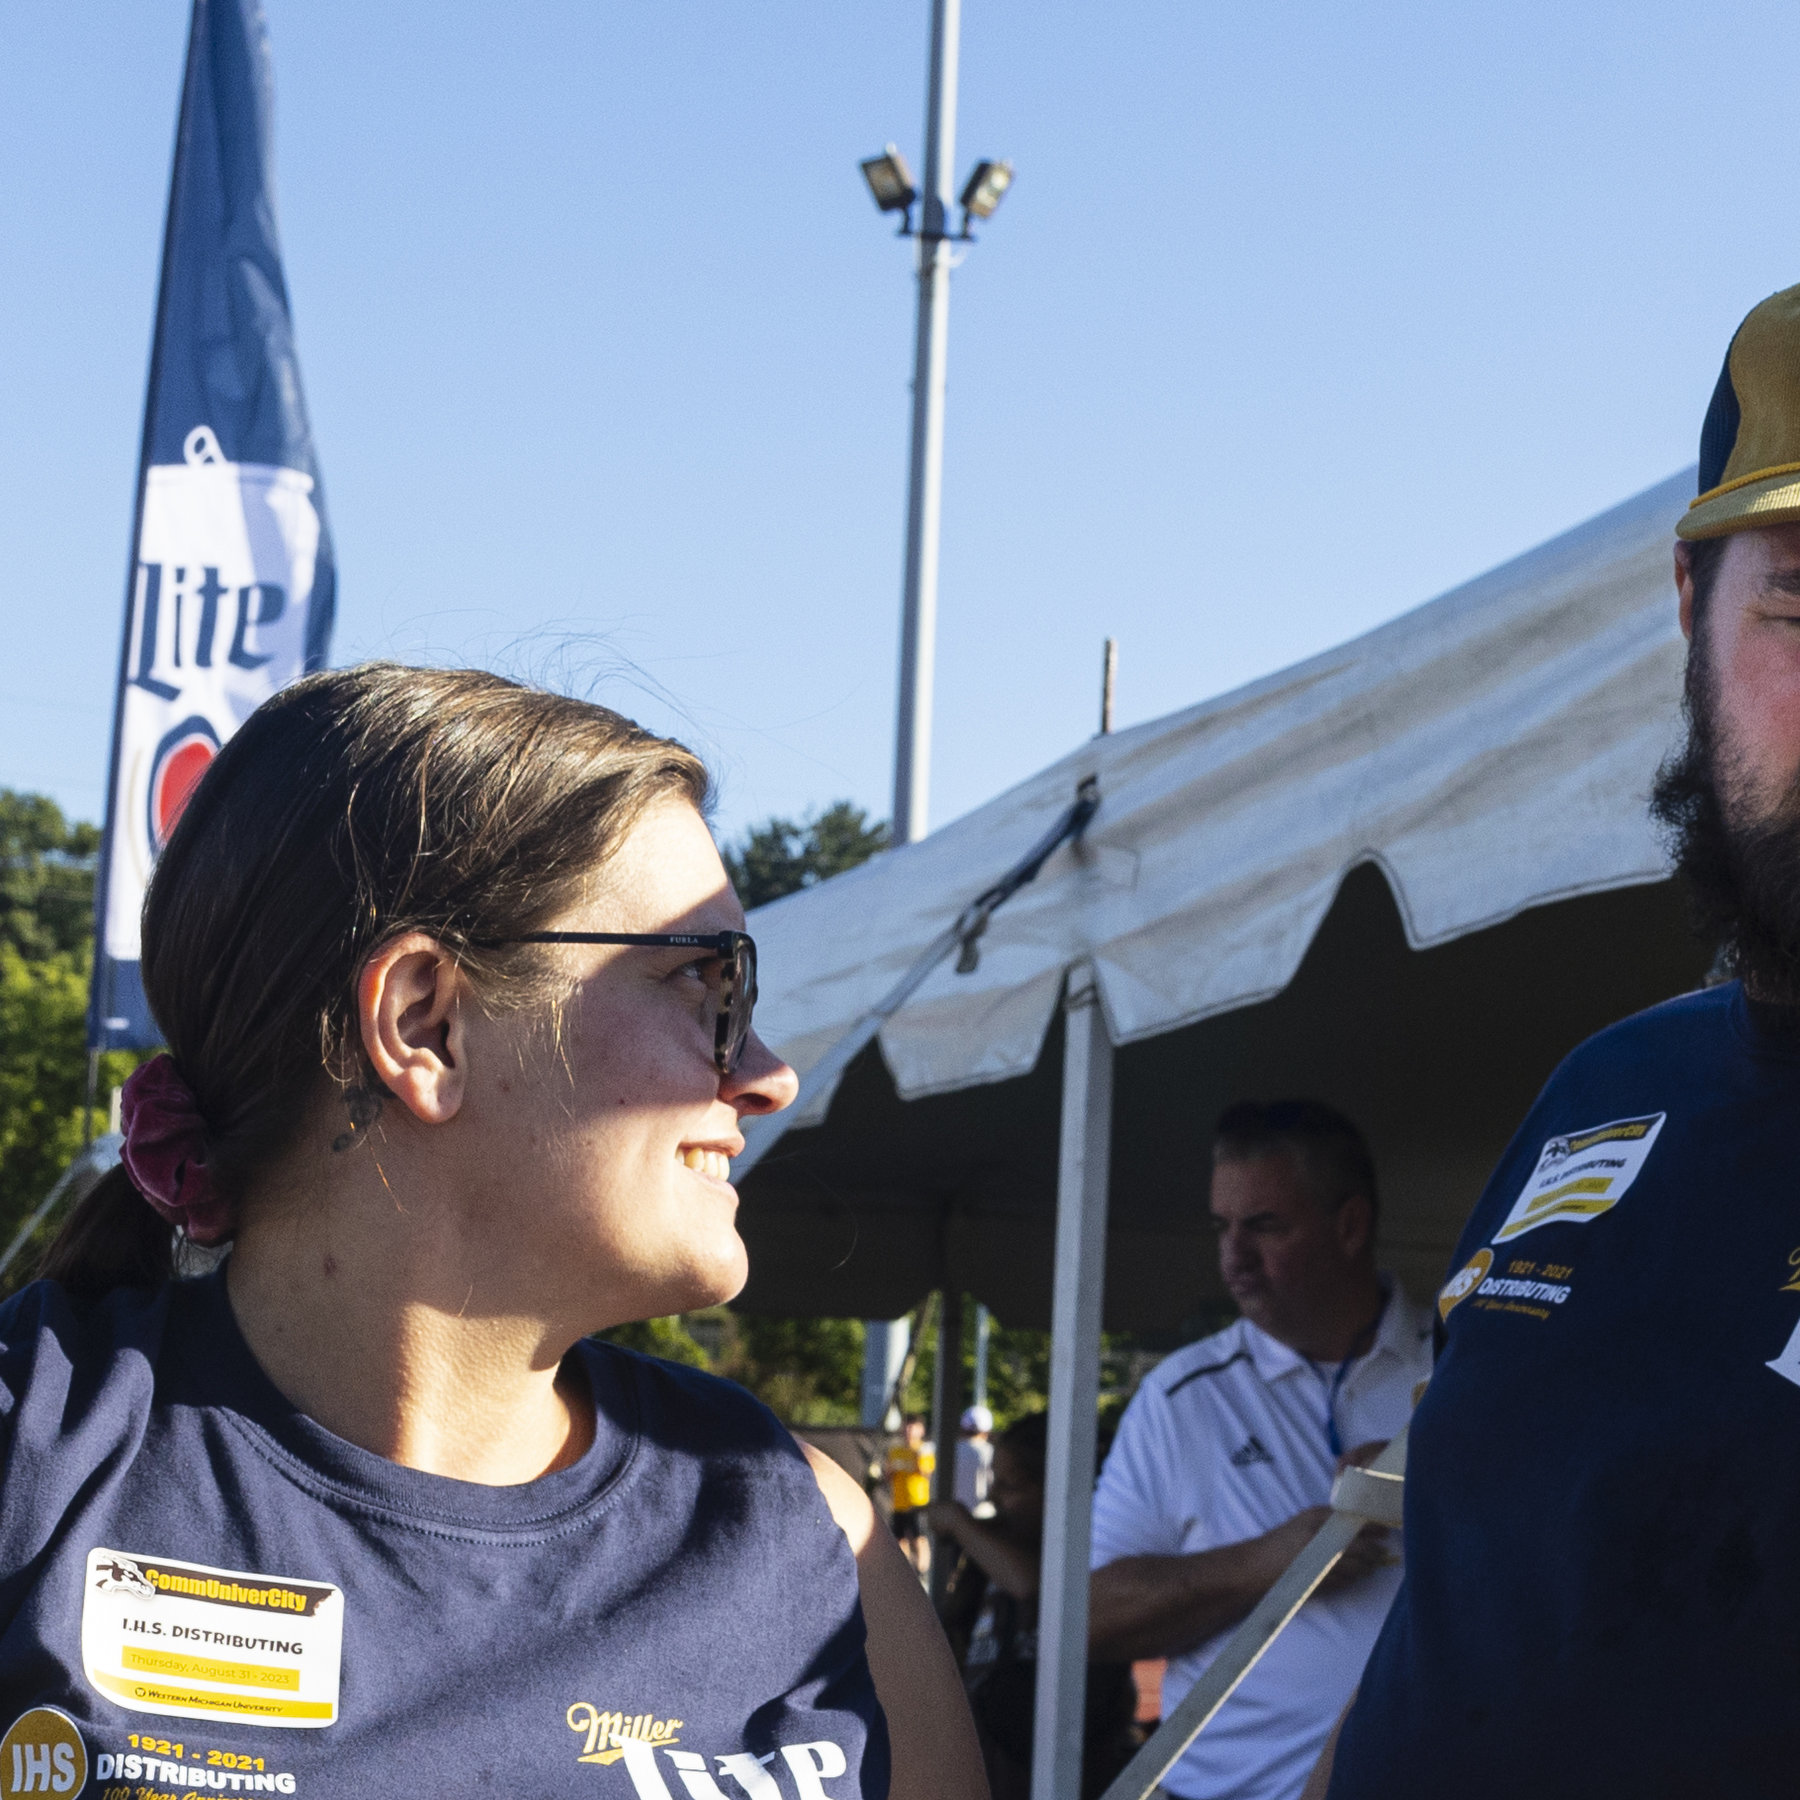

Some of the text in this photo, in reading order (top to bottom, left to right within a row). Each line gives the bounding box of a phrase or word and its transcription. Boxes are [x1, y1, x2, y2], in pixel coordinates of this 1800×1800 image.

[128, 561, 288, 702] Lite
[1477, 1277, 1572, 1304] DISTRIBUTING
[145, 1569, 307, 1612] CommUniverCity
[122, 1617, 304, 1655] I.H.S. DISTRIBUTING
[131, 1653, 190, 1673] Thursday,
[192, 1663, 236, 1681] August
[239, 1668, 252, 1680] 31
[260, 1671, 290, 1685] 2023
[566, 1702, 684, 1754] Miller
[10, 1742, 76, 1793] IHS
[127, 1734, 185, 1759] 1921
[206, 1750, 265, 1771] 2021
[96, 1753, 297, 1794] DISTRIBUTING
